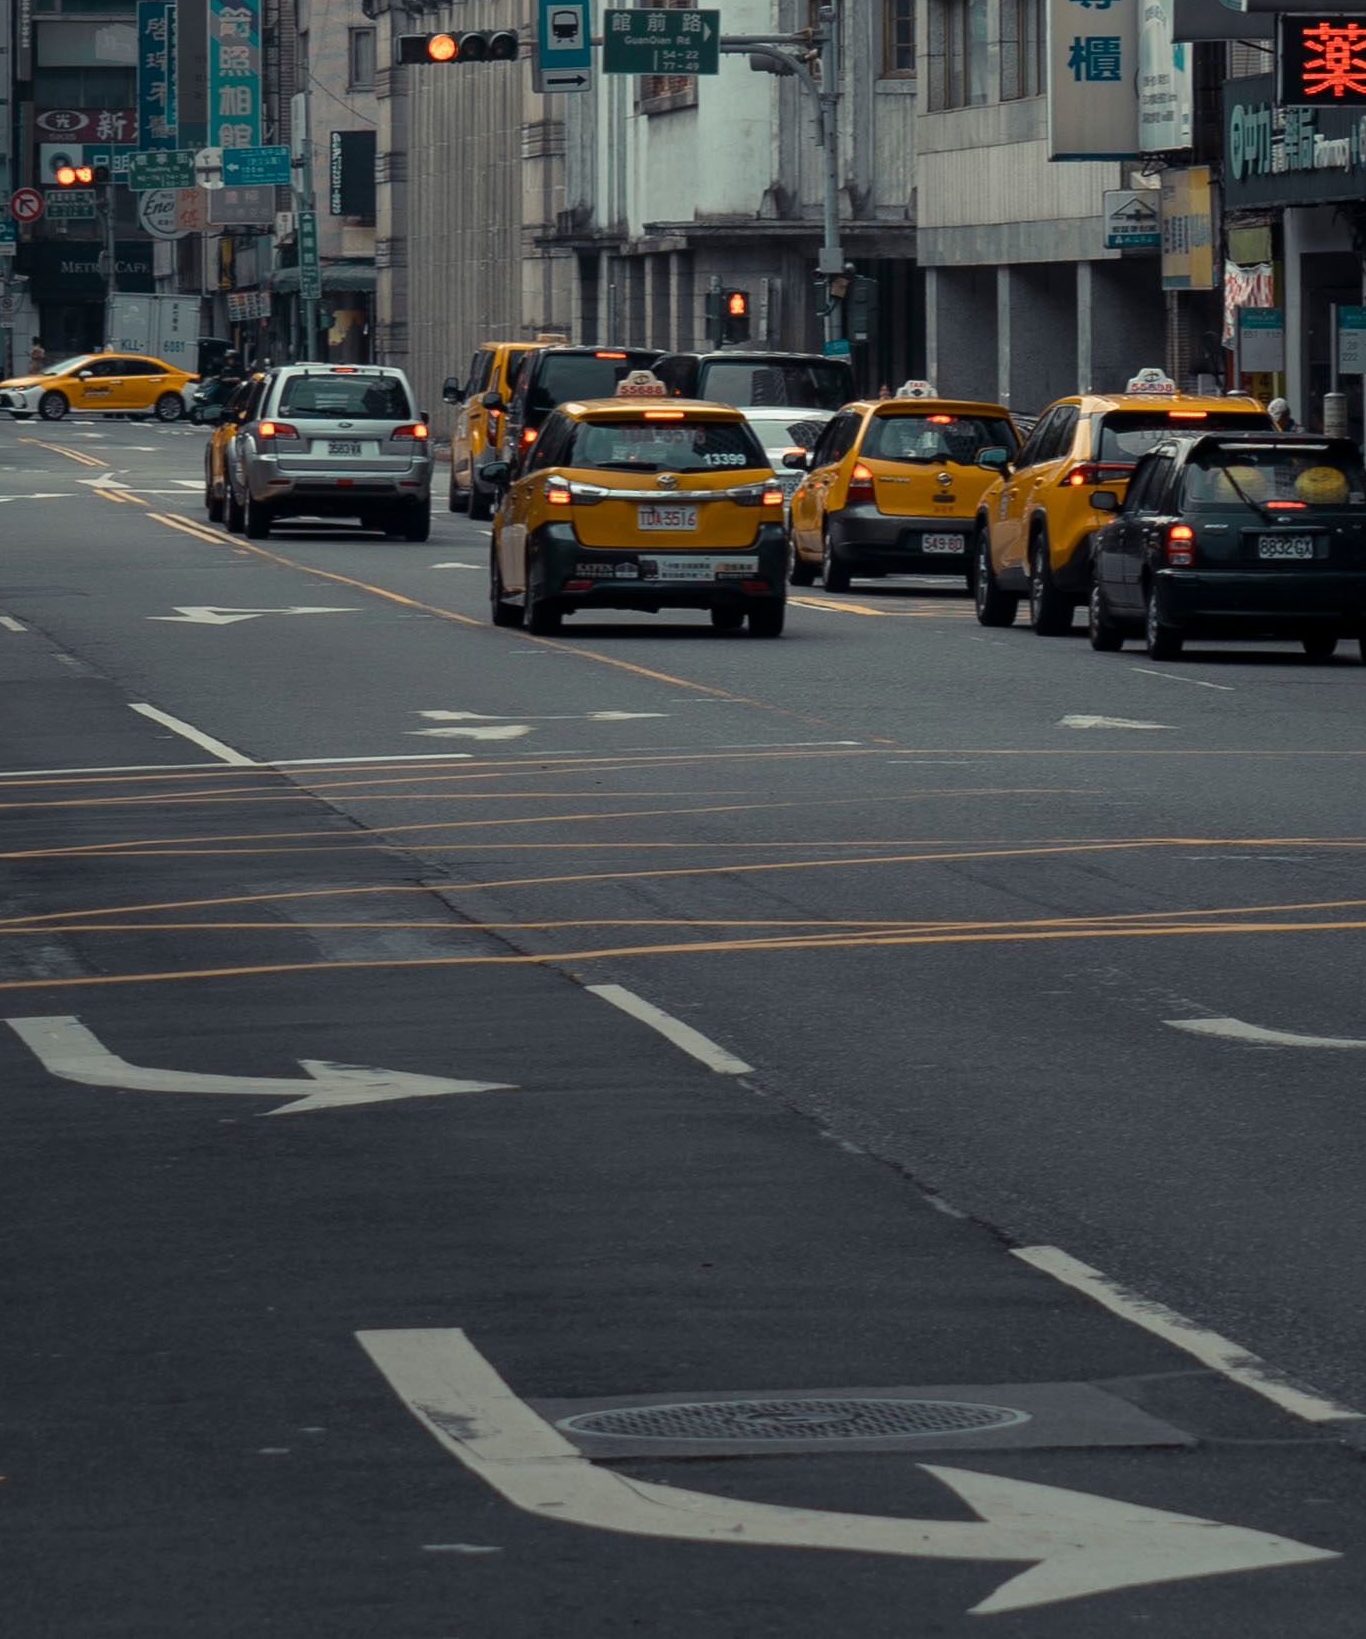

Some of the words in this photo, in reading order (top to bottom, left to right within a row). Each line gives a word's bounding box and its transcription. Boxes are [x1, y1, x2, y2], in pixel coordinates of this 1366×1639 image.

[611, 13, 702, 32] 館前路
[662, 50, 700, 59] 54-22
[60, 260, 113, 274] METR
[620, 385, 664, 395] 55688
[702, 453, 747, 466] 13399
